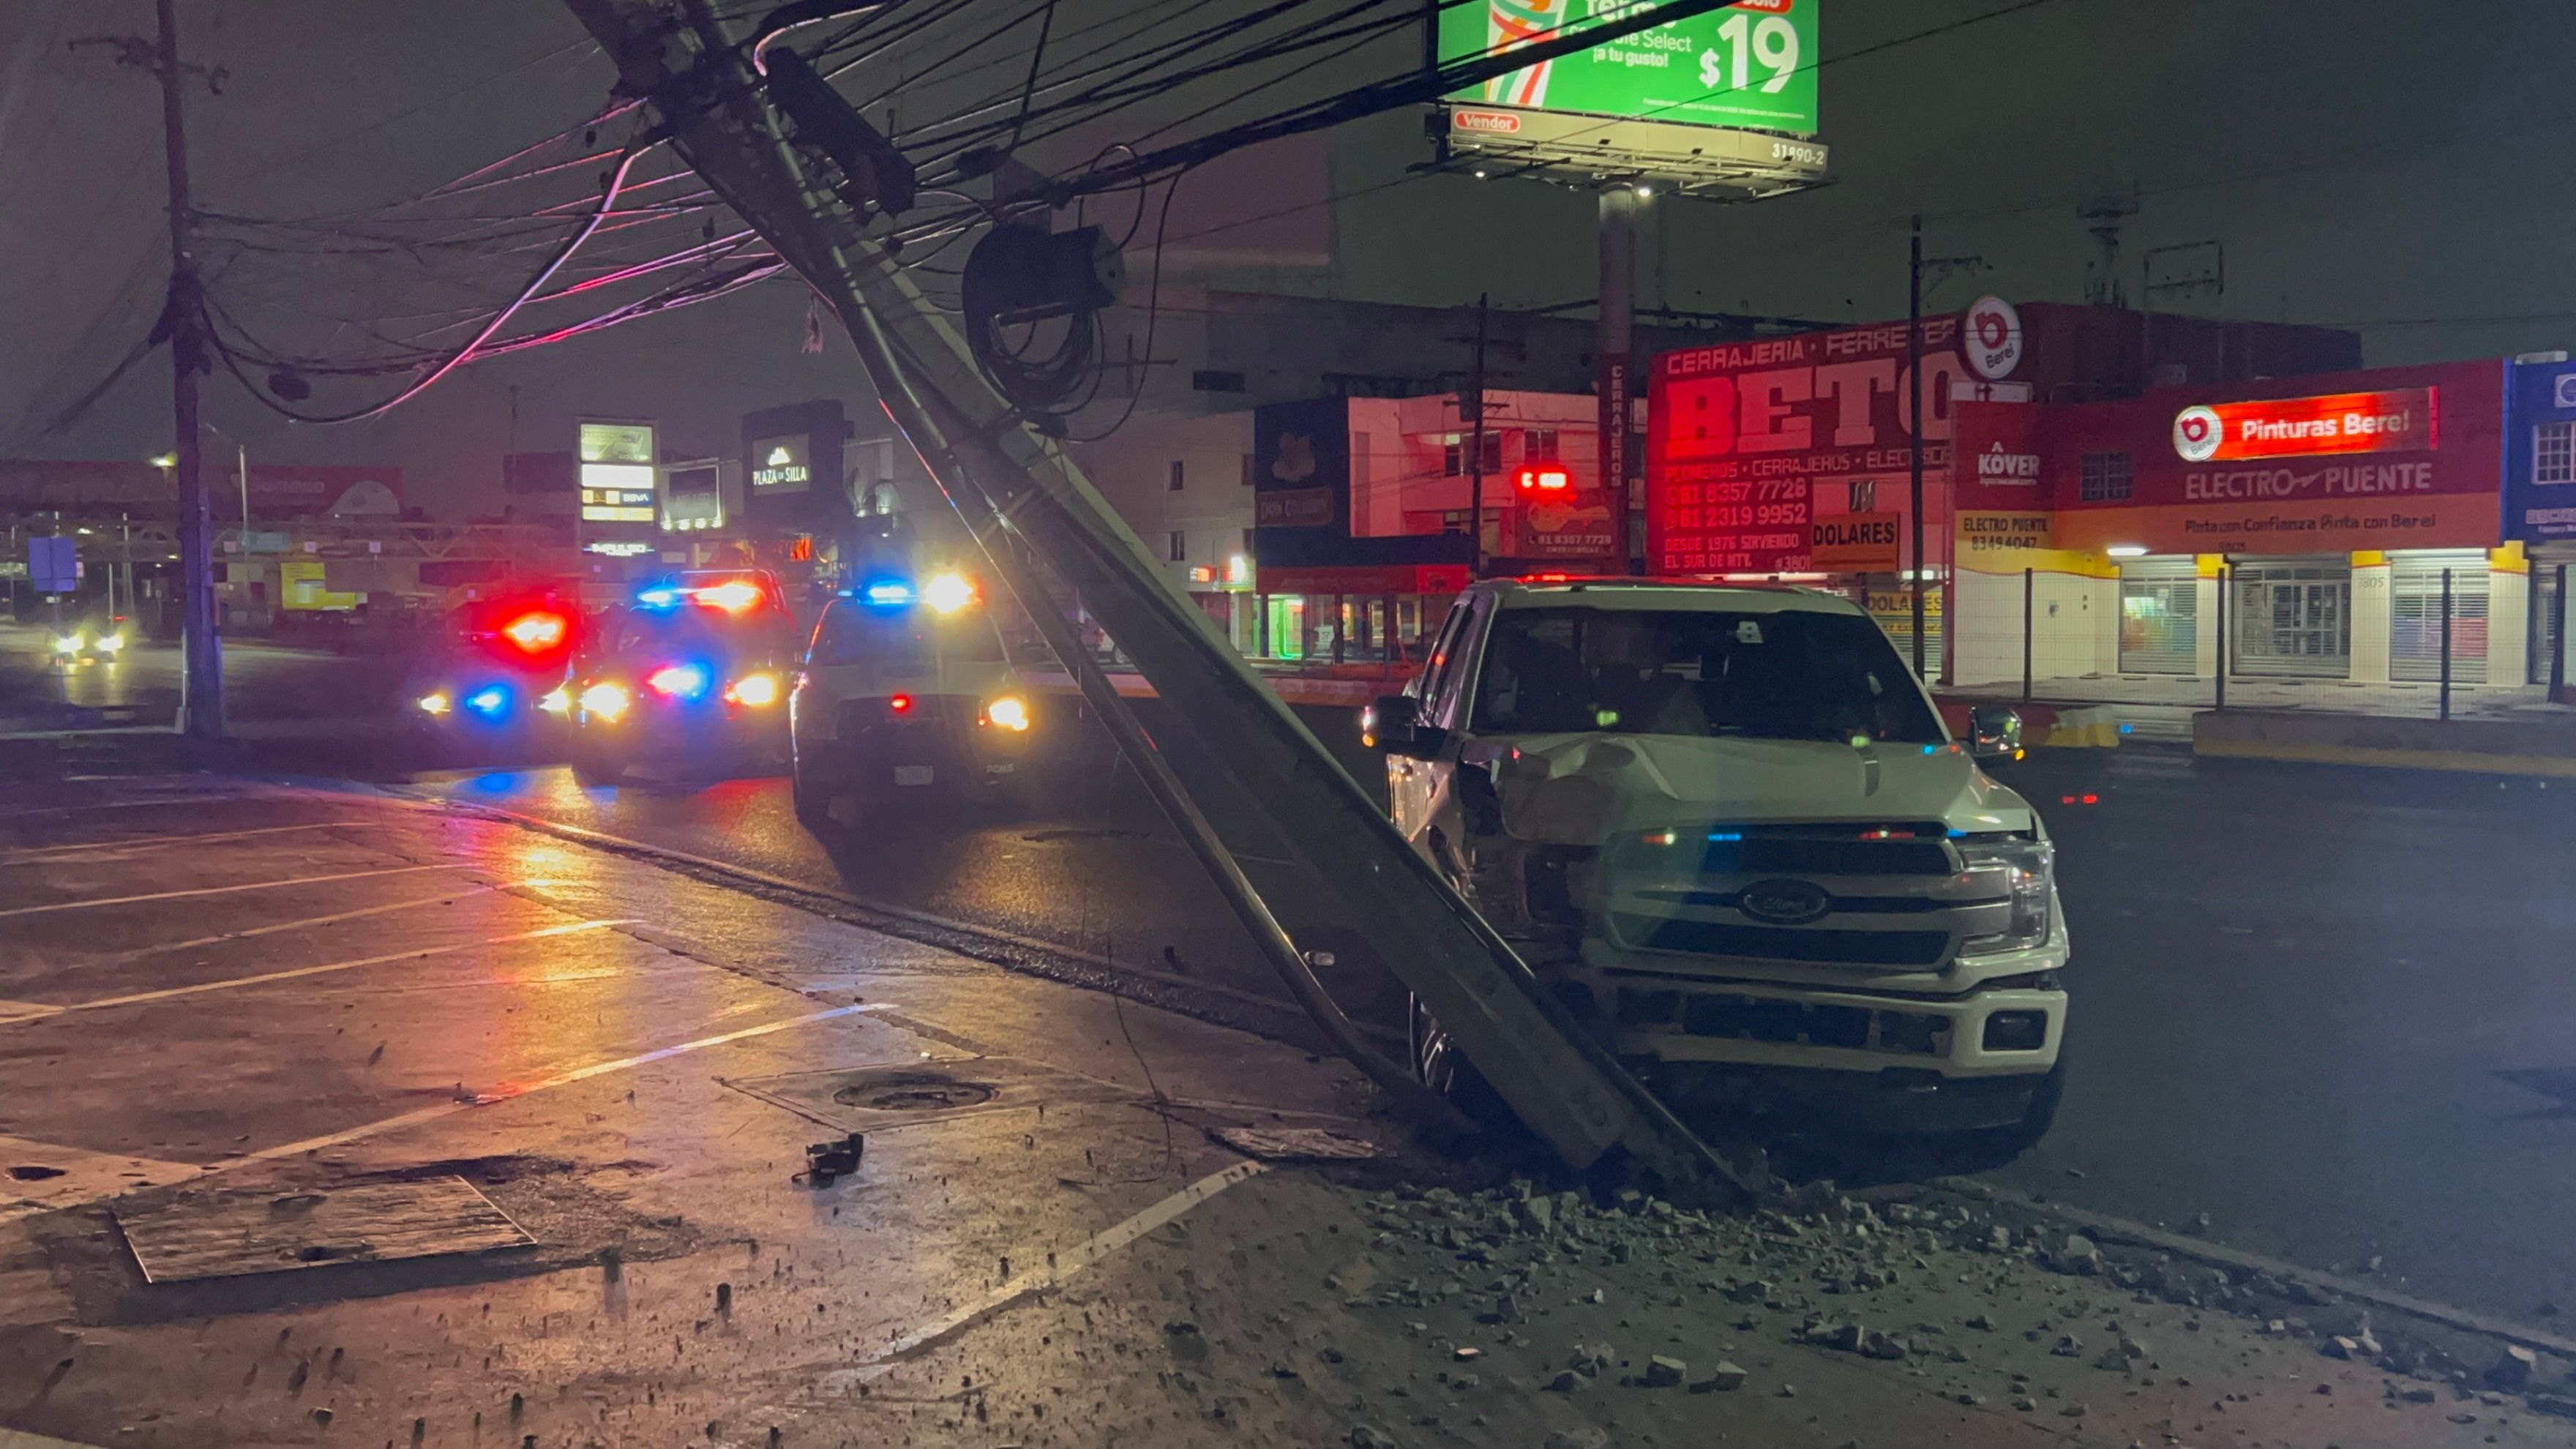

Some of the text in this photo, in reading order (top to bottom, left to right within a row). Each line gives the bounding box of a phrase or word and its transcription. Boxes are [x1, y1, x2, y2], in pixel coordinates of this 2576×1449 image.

[1643, 30, 1692, 52] Select
[1609, 48, 1623, 62] tu
[1626, 52, 1669, 67] gusto!
[1699, 13, 1799, 94] $19
[1463, 114, 1513, 130] Vendor
[1772, 143, 1824, 165] 31890-2
[1667, 340, 1805, 375] CERRAJERIA
[1985, 342, 2014, 369] Berel
[1666, 351, 1967, 460] BETO
[2242, 409, 2409, 441] Pinturas Berel
[1752, 453, 1850, 476] CERRAJEROS
[752, 469, 777, 486] PLAZA
[785, 466, 807, 482] SILLA
[2185, 463, 2433, 500] ELECTRO PUENTE
[623, 493, 649, 503] BBVA
[1706, 482, 1752, 503] 8357
[1758, 478, 1807, 501] 7728
[1706, 506, 1753, 527] 2319
[1757, 503, 1807, 525] 9952
[1963, 517, 2048, 532] ELECTRO PUENTE
[2364, 517, 2388, 529] con
[2392, 514, 2435, 528] Berel
[1665, 537, 1703, 552] DESDE
[1708, 536, 1737, 550] 1976
[1813, 522, 1895, 546] DOLARES
[1665, 555, 1680, 569] EL
[1684, 554, 1706, 568] SUR
[1709, 554, 1723, 567] DE
[1868, 596, 1942, 612] DOLAES
